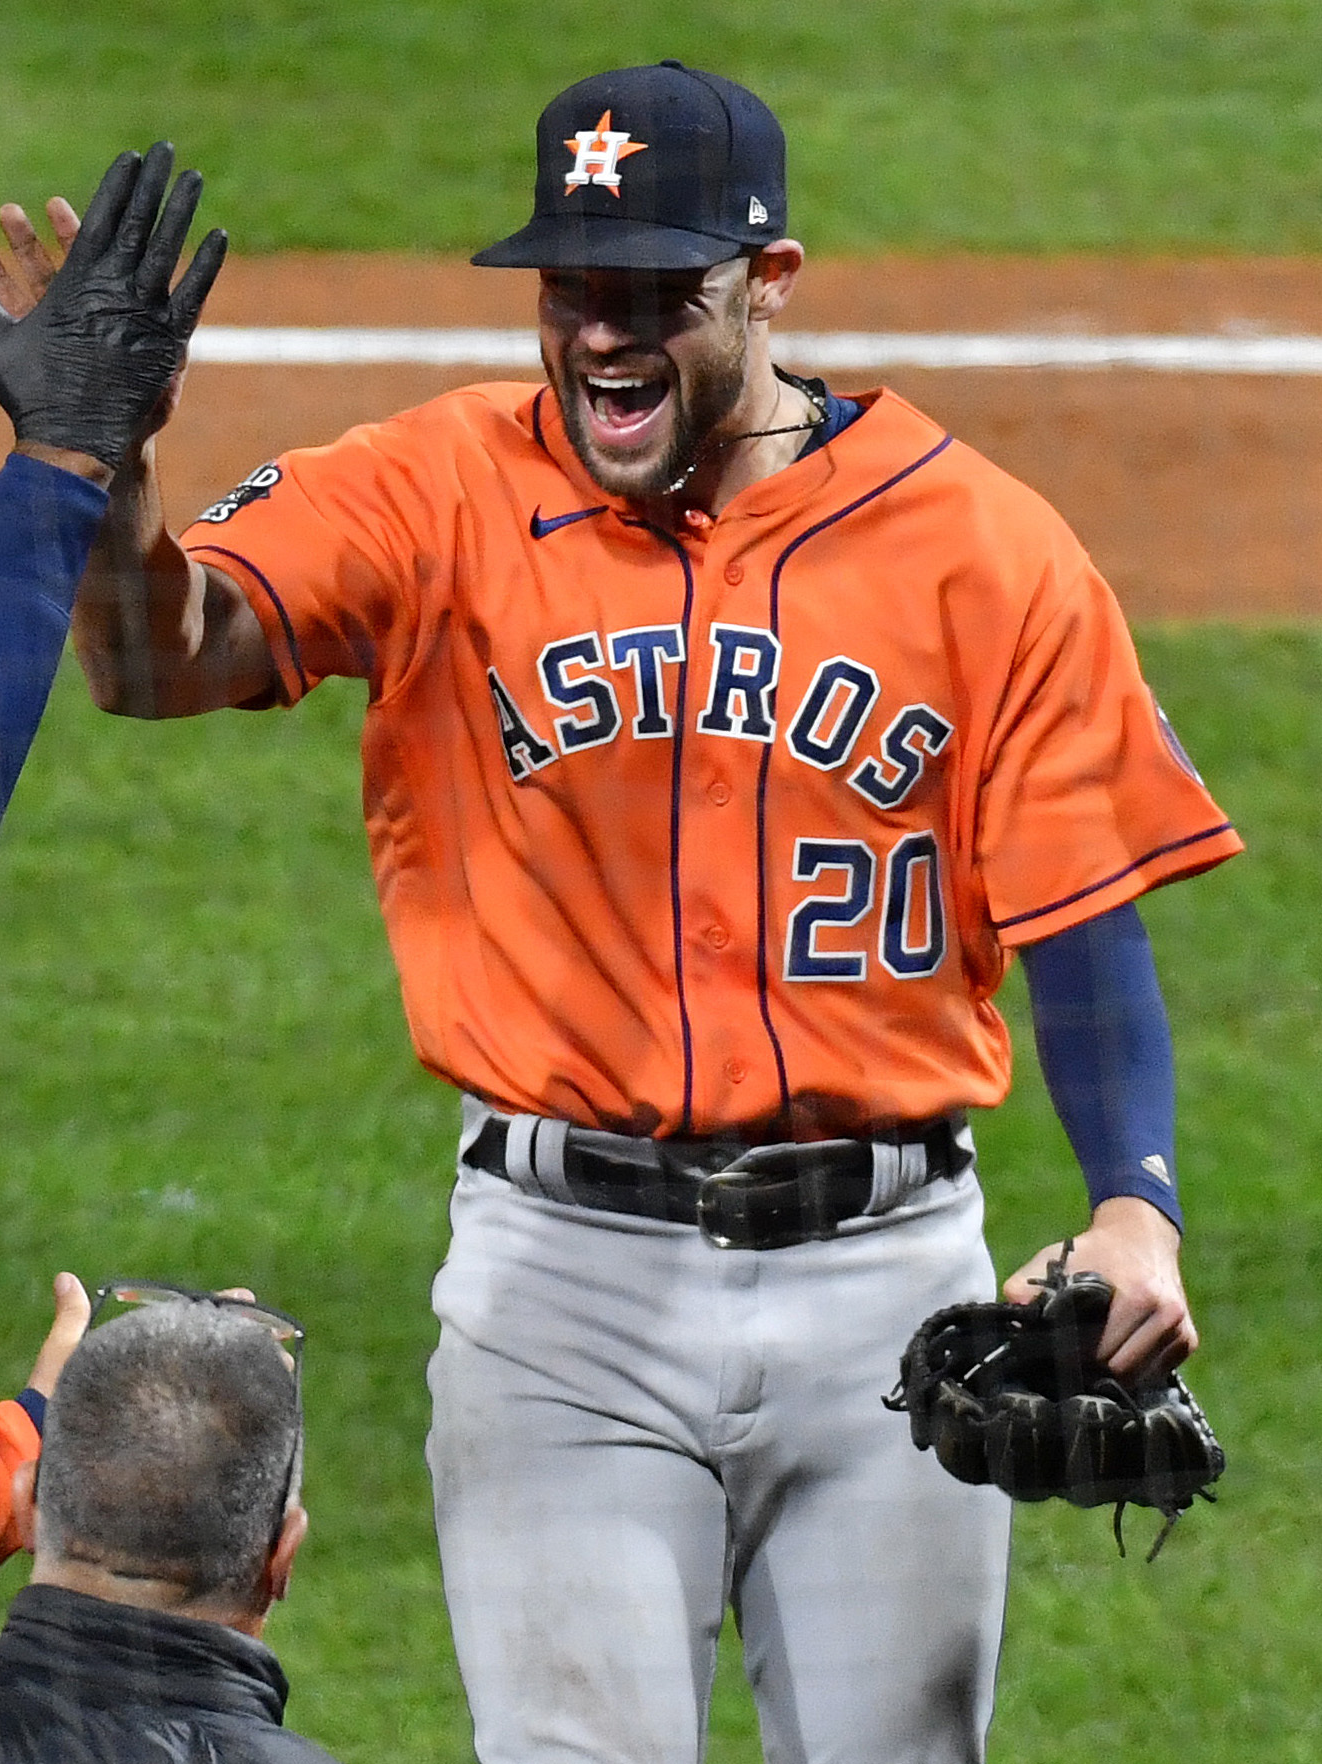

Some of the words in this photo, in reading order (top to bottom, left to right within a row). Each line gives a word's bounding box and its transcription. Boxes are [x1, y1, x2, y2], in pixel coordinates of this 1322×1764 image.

[565, 131, 631, 185] H
[487, 622, 954, 809] ASTROS
[783, 830, 947, 982] 20
